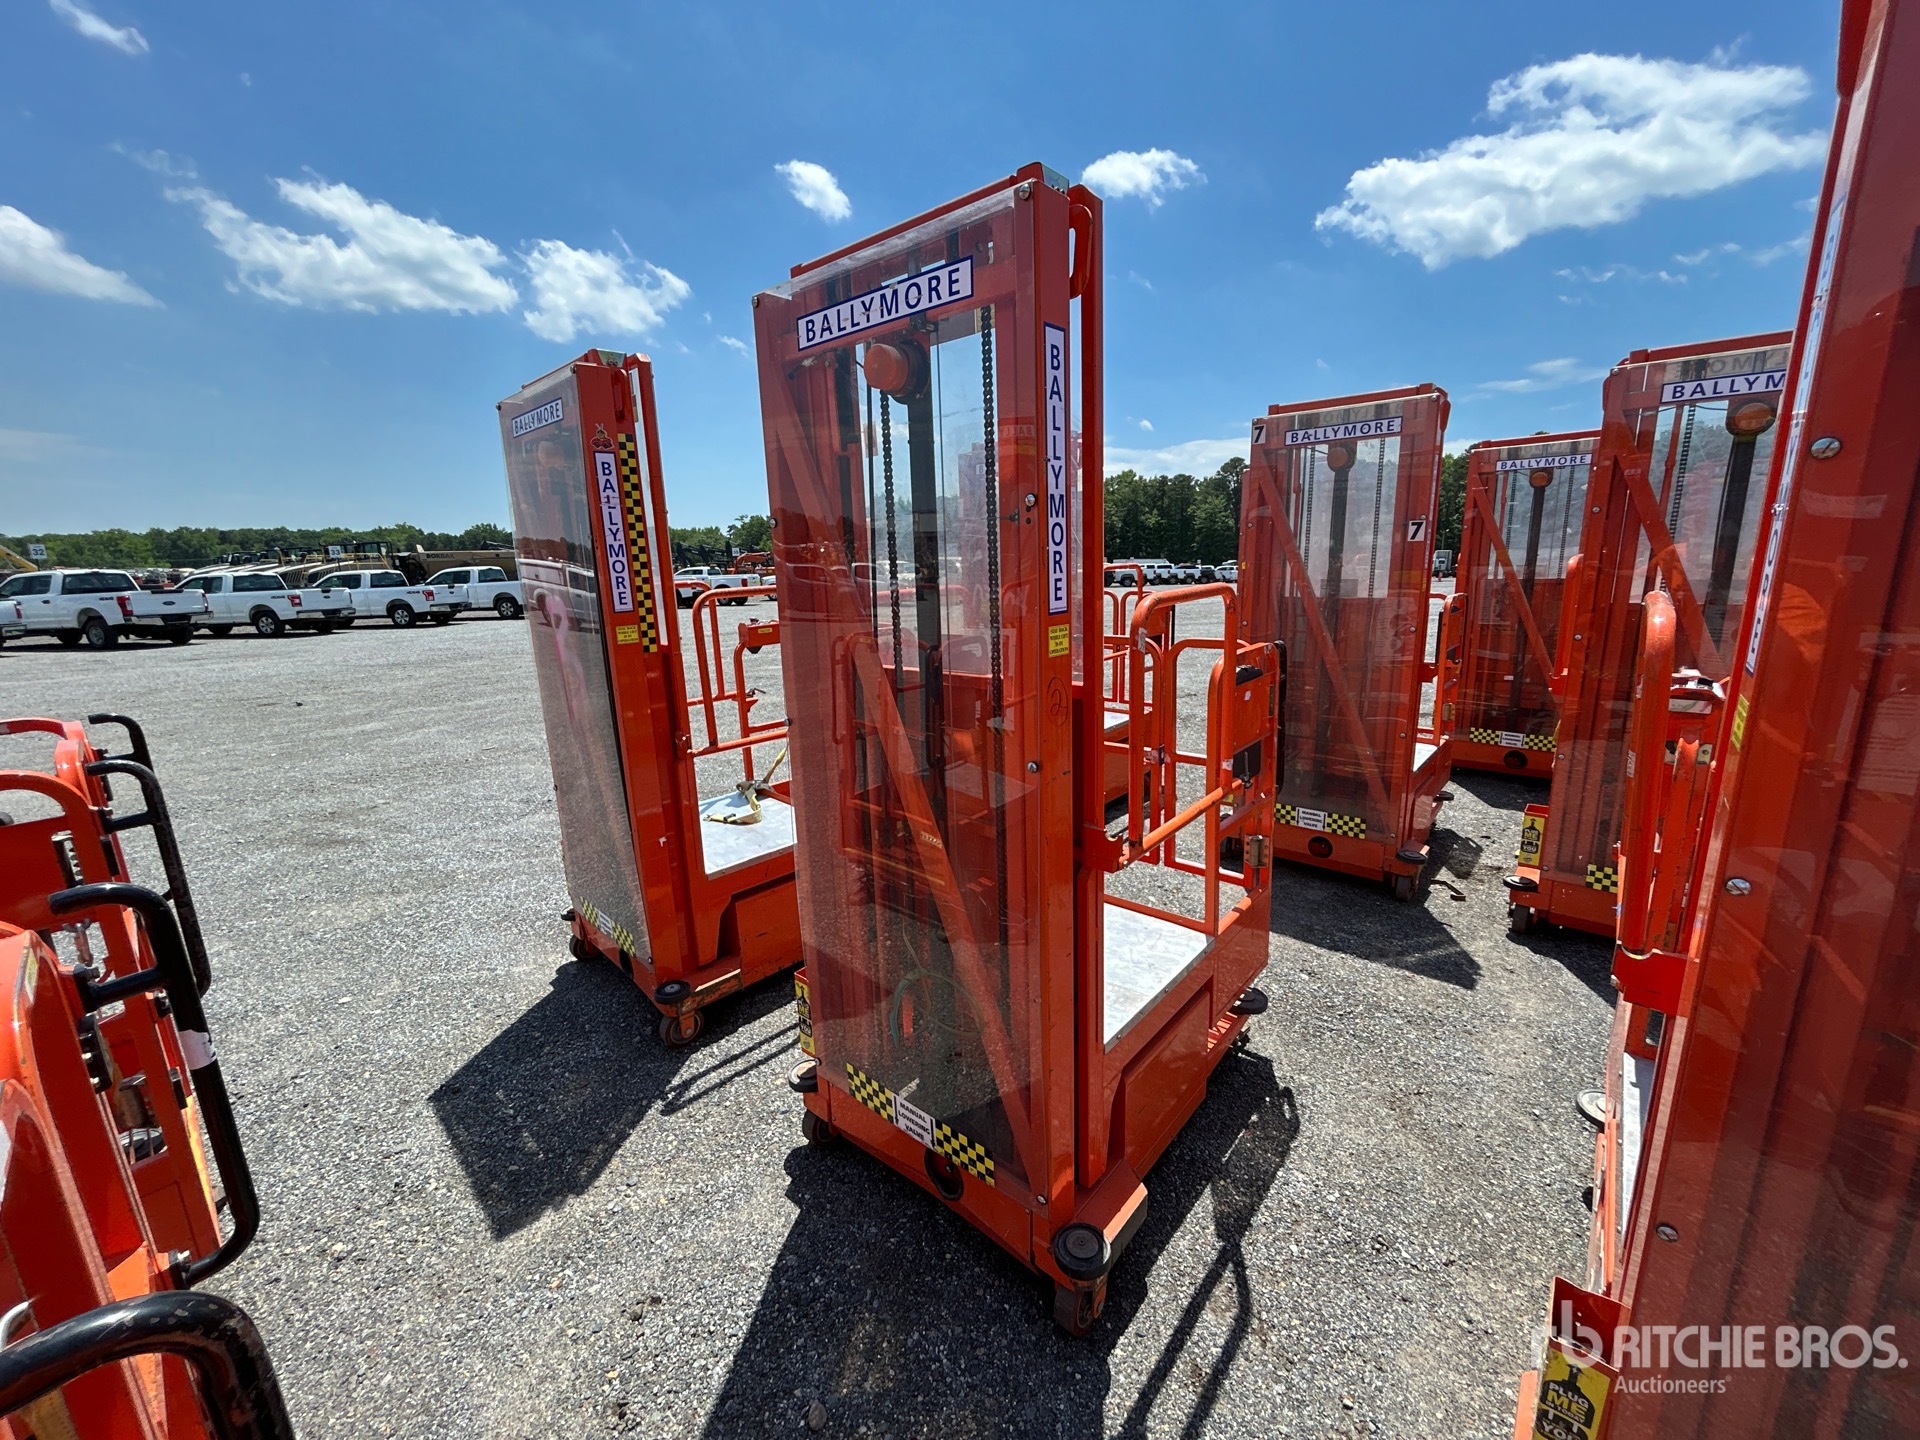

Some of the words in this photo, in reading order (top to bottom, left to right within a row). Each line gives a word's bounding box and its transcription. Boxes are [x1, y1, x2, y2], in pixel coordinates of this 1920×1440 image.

[805, 267, 961, 343] BALLYMORE
[513, 401, 562, 434] BALLYMORE
[1254, 425, 1265, 444] 7
[1291, 419, 1396, 443] BALLYMORE
[1048, 345, 1066, 602] BALLYMORE
[1500, 455, 1587, 470] BALLYMORE
[600, 461, 629, 606] BALLYMORE
[1409, 521, 1424, 540] 7
[32, 548, 45, 556] 32
[897, 1112, 931, 1135] LOWERING
[899, 1101, 927, 1123] MANUAL
[904, 1123, 925, 1141] VALVE
[1546, 1390, 1588, 1420] ME
[1548, 1382, 1589, 1409] PLUG
[1555, 1405, 1587, 1424] TODAY
